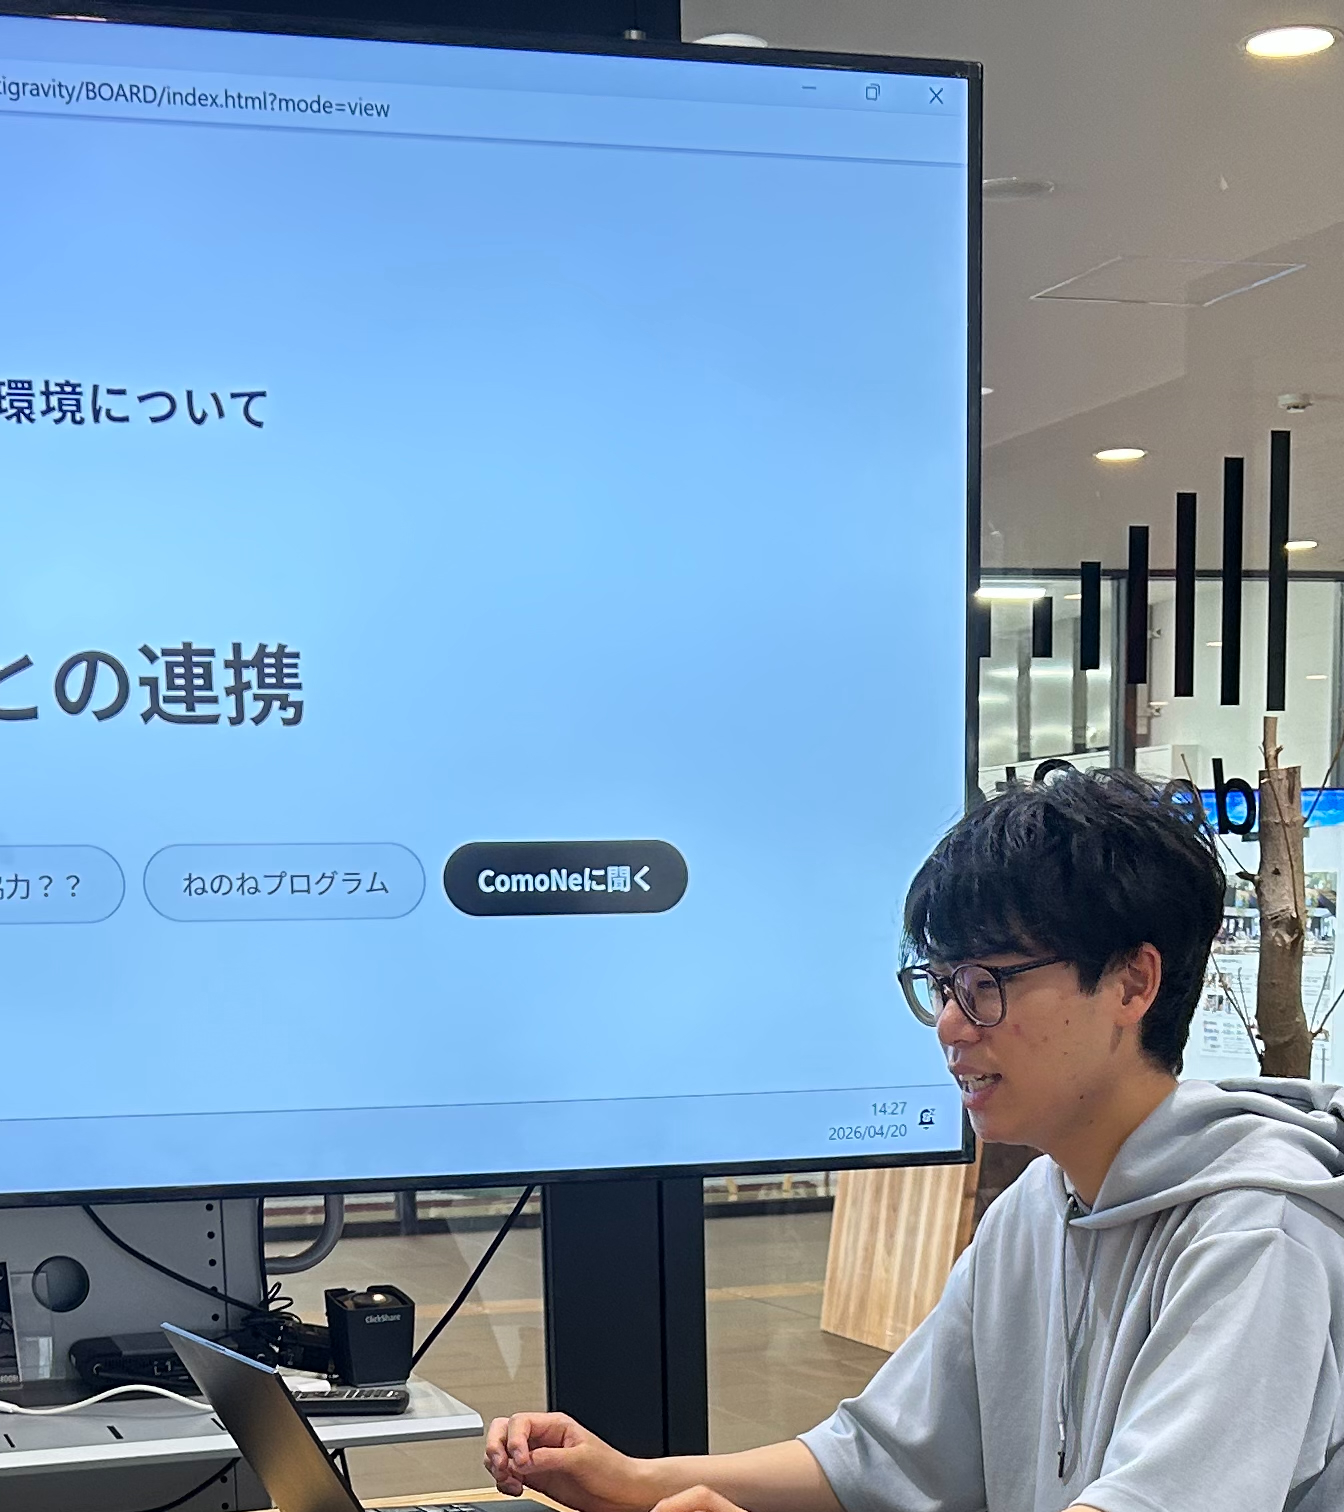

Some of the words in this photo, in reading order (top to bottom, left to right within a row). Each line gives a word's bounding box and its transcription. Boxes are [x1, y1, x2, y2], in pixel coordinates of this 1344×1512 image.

[182, 869, 390, 898] ねのねプログラム
[477, 864, 652, 895] ComoNeに聞く
[871, 1101, 907, 1117] 14:27
[828, 1124, 907, 1141] 2026/04/20
